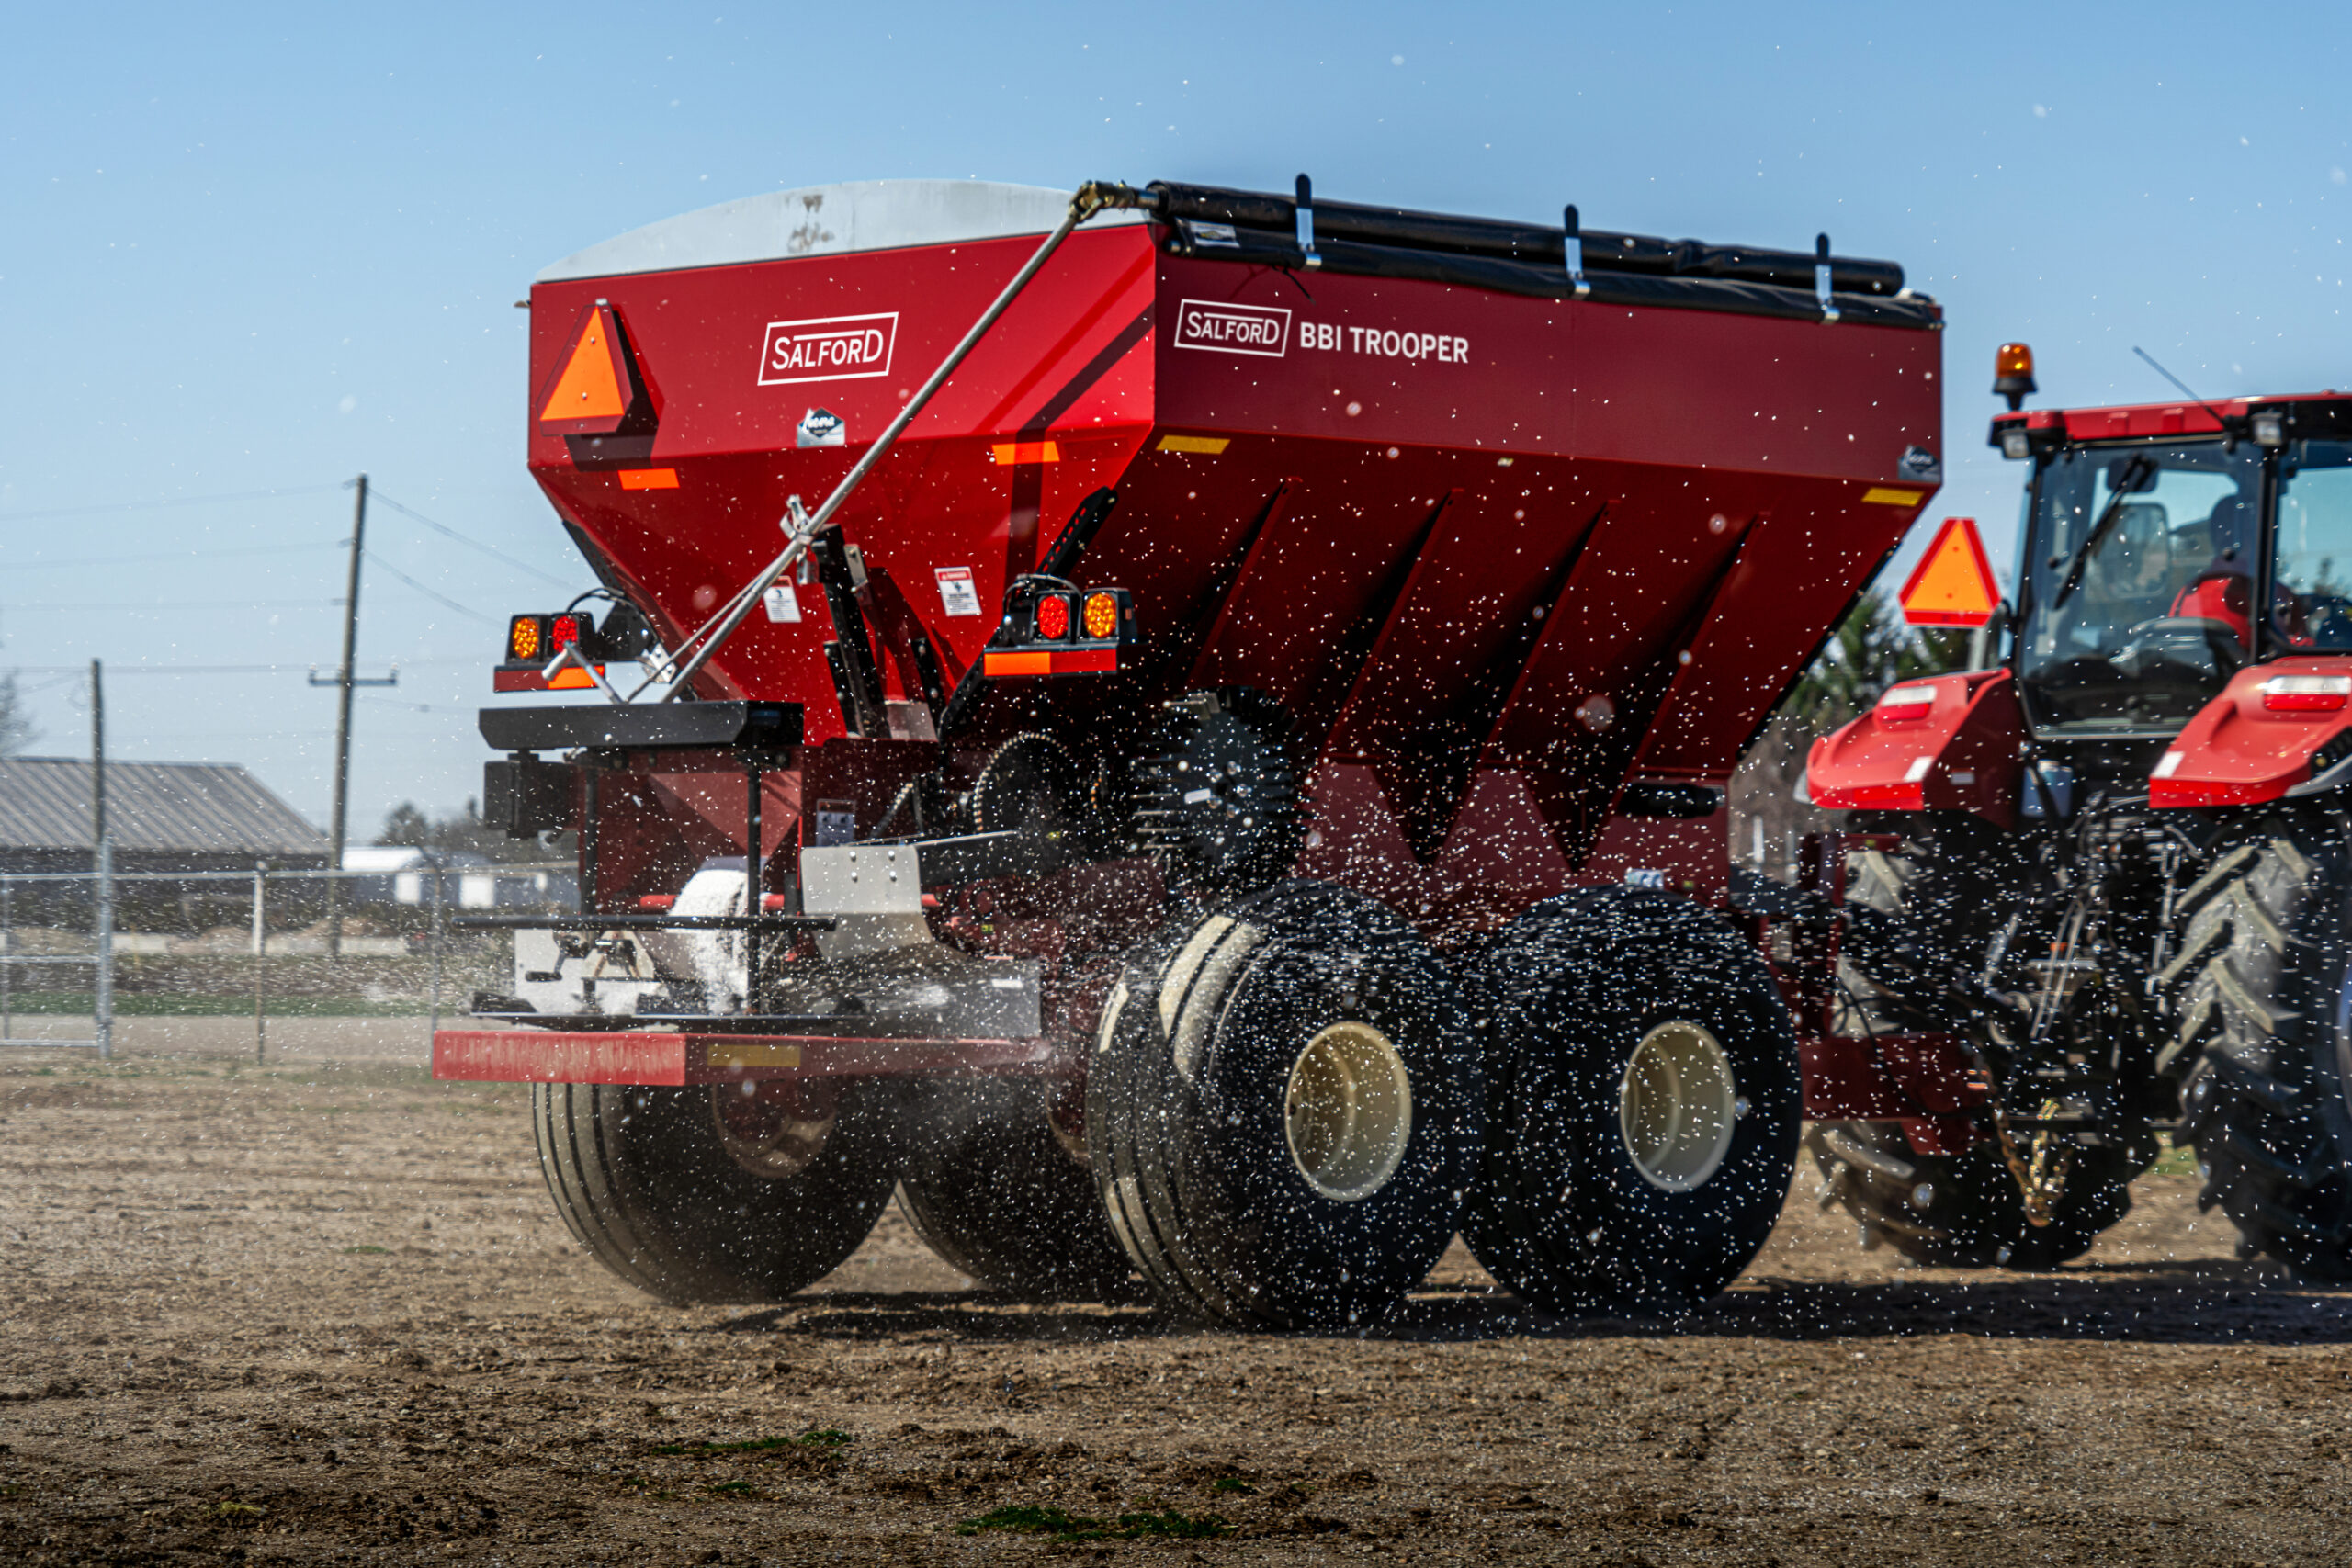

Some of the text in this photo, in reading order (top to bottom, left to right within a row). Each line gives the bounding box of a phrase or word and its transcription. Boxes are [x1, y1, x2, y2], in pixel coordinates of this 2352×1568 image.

[1185, 311, 1280, 344] SALFORD
[1300, 321, 1469, 364] BBI TROOPER
[772, 329, 884, 370] SALFORD
